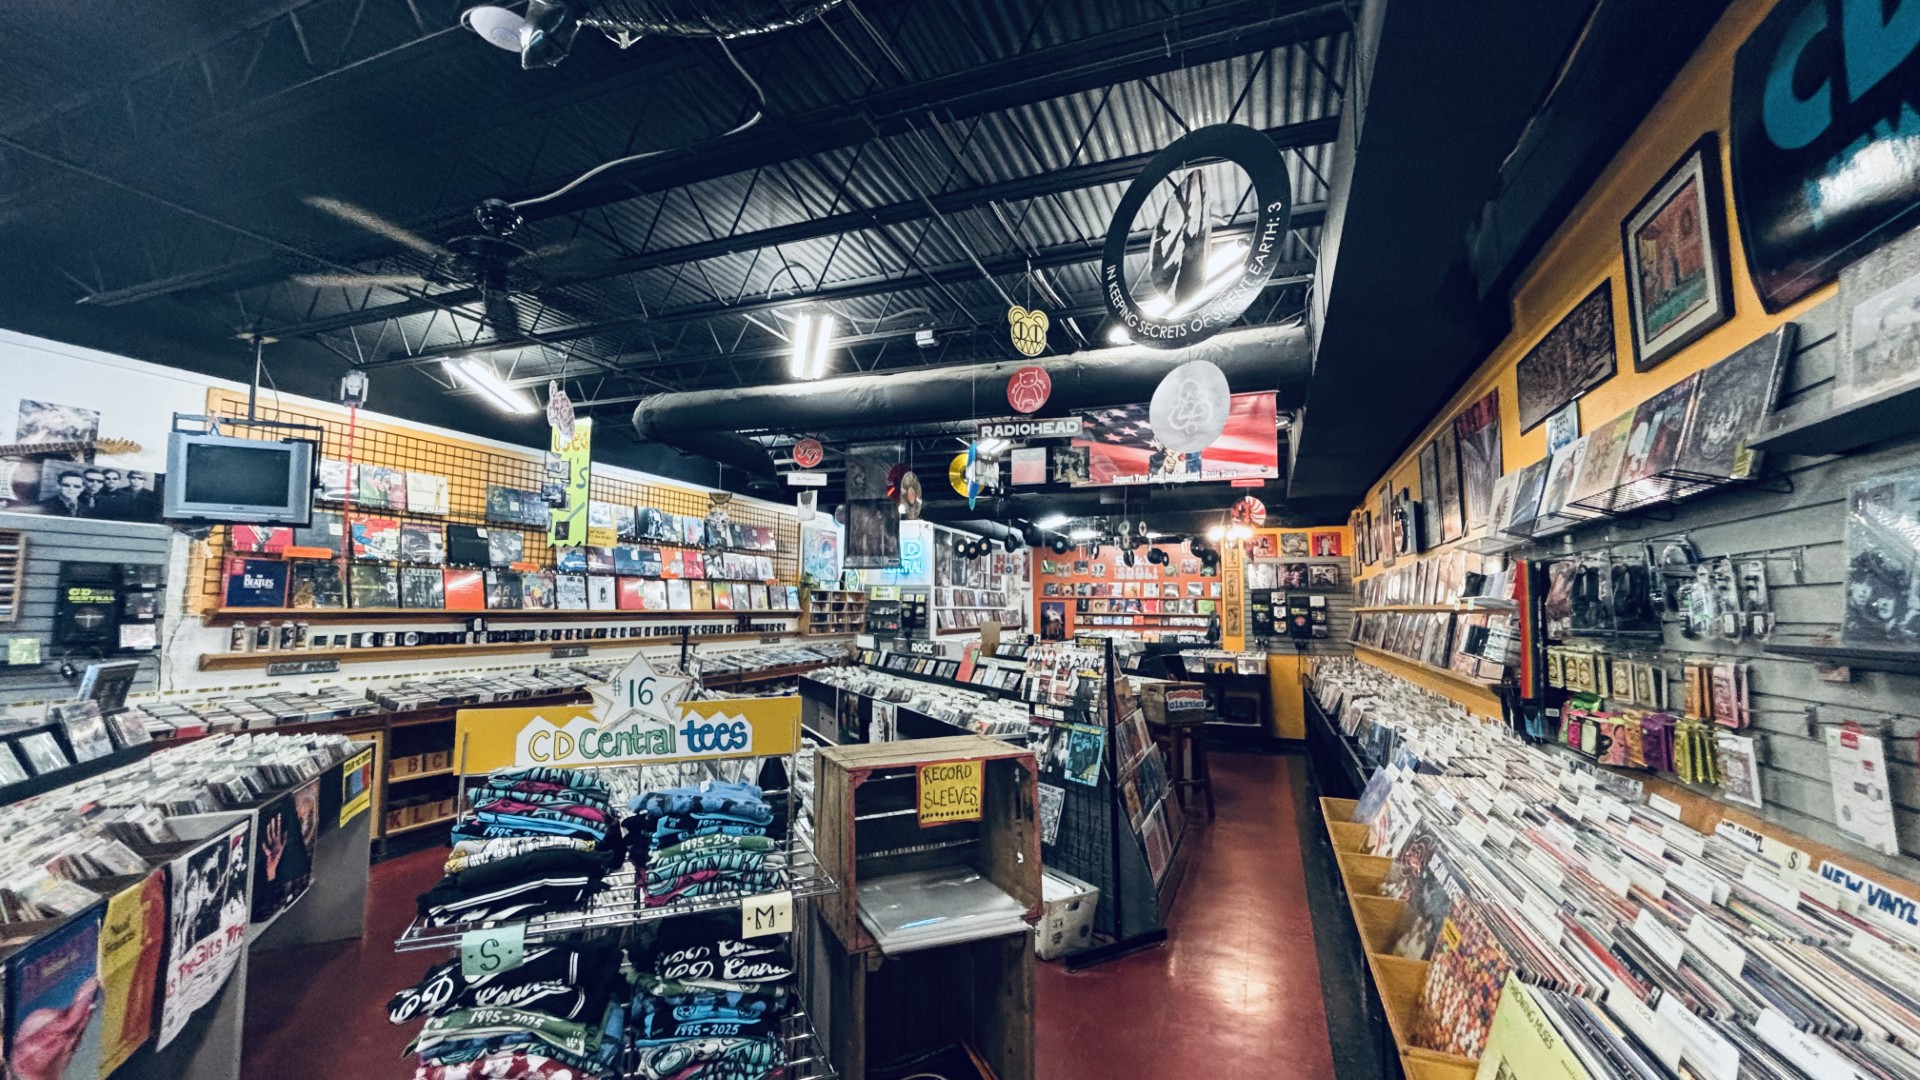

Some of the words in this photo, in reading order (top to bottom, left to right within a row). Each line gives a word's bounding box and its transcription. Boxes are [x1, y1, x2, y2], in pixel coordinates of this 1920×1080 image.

[1248, 215, 1282, 276] EARTH:
[1106, 264, 1116, 280] IN
[1108, 280, 1138, 328] KEEPING
[1137, 321, 1187, 339] SECRETS
[982, 421, 1078, 437] RADIOHEAD
[996, 555, 1018, 563] HiP
[994, 565, 1021, 574] HOP
[911, 642, 934, 653] ROCK
[629, 676, 656, 708] 16
[528, 729, 575, 762] CD
[578, 722, 677, 760] Central
[680, 719, 748, 753] tees
[924, 764, 972, 785] RECORD
[1788, 851, 1798, 870] S
[1822, 864, 1863, 893] NEW
[1867, 884, 1919, 926] VINYL
[1507, 977, 1537, 1025] THROWING
[1532, 1014, 1555, 1050] MUSES
[674, 1024, 741, 1036] 1995-2025
[1677, 1007, 1718, 1046] TORTOISE
